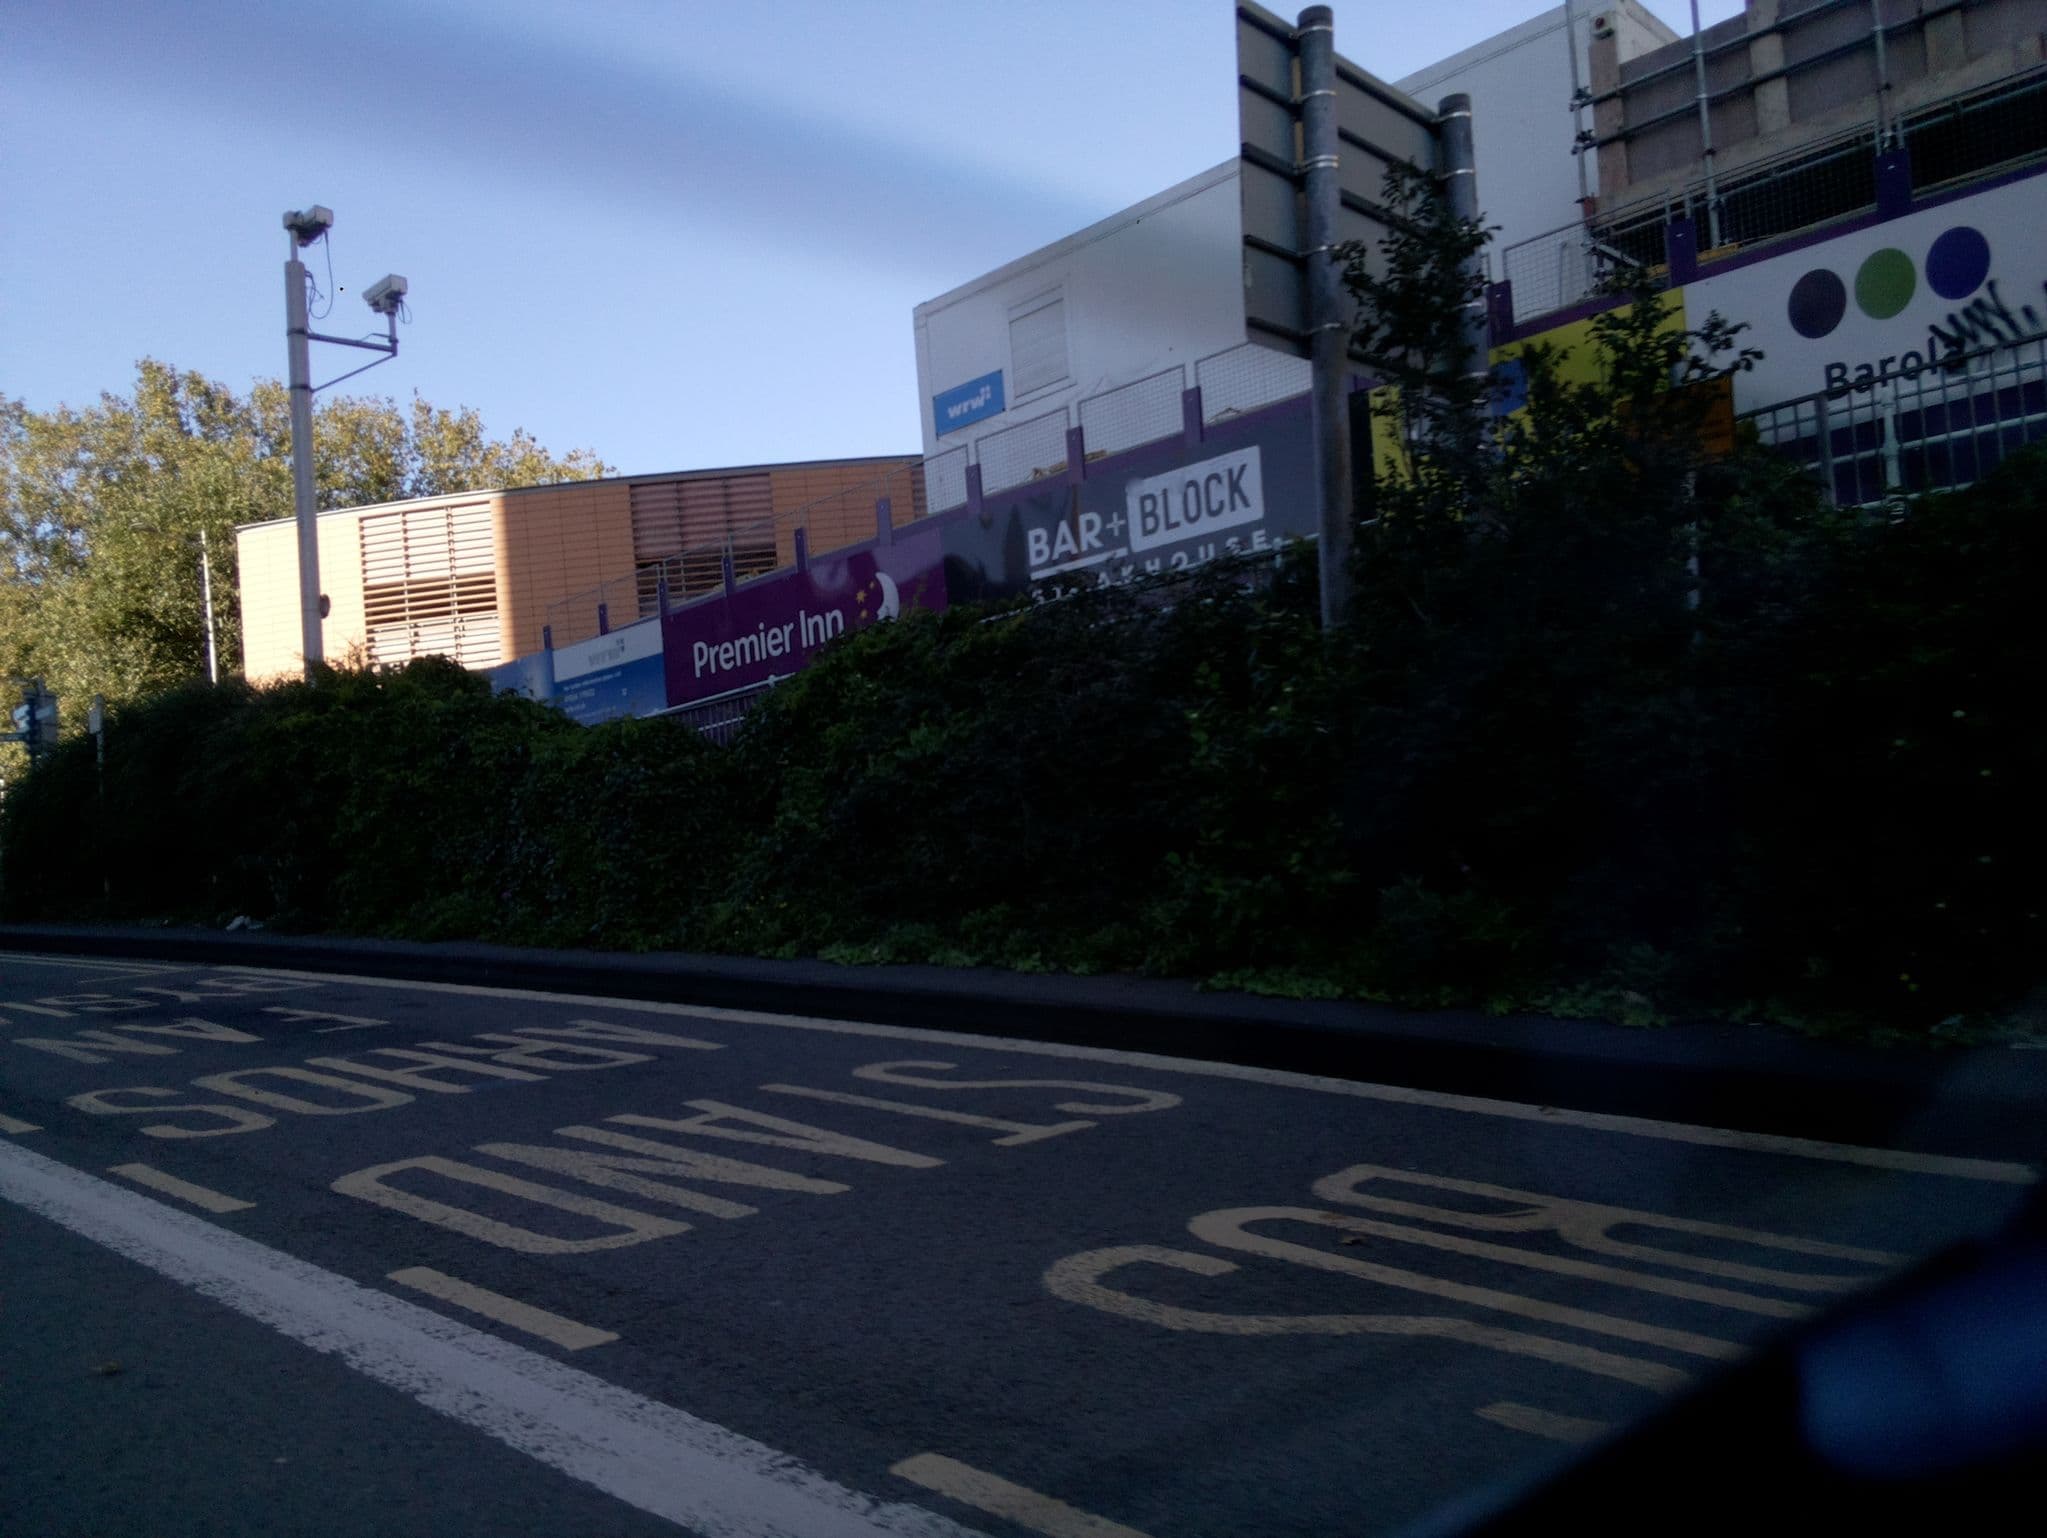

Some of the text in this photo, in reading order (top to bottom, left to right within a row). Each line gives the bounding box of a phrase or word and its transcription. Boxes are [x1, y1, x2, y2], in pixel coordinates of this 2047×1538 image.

[1139, 463, 1251, 537] BLOCK
[1031, 528, 1271, 605] STAKHOUSE
[693, 598, 845, 679] Premier Inn
